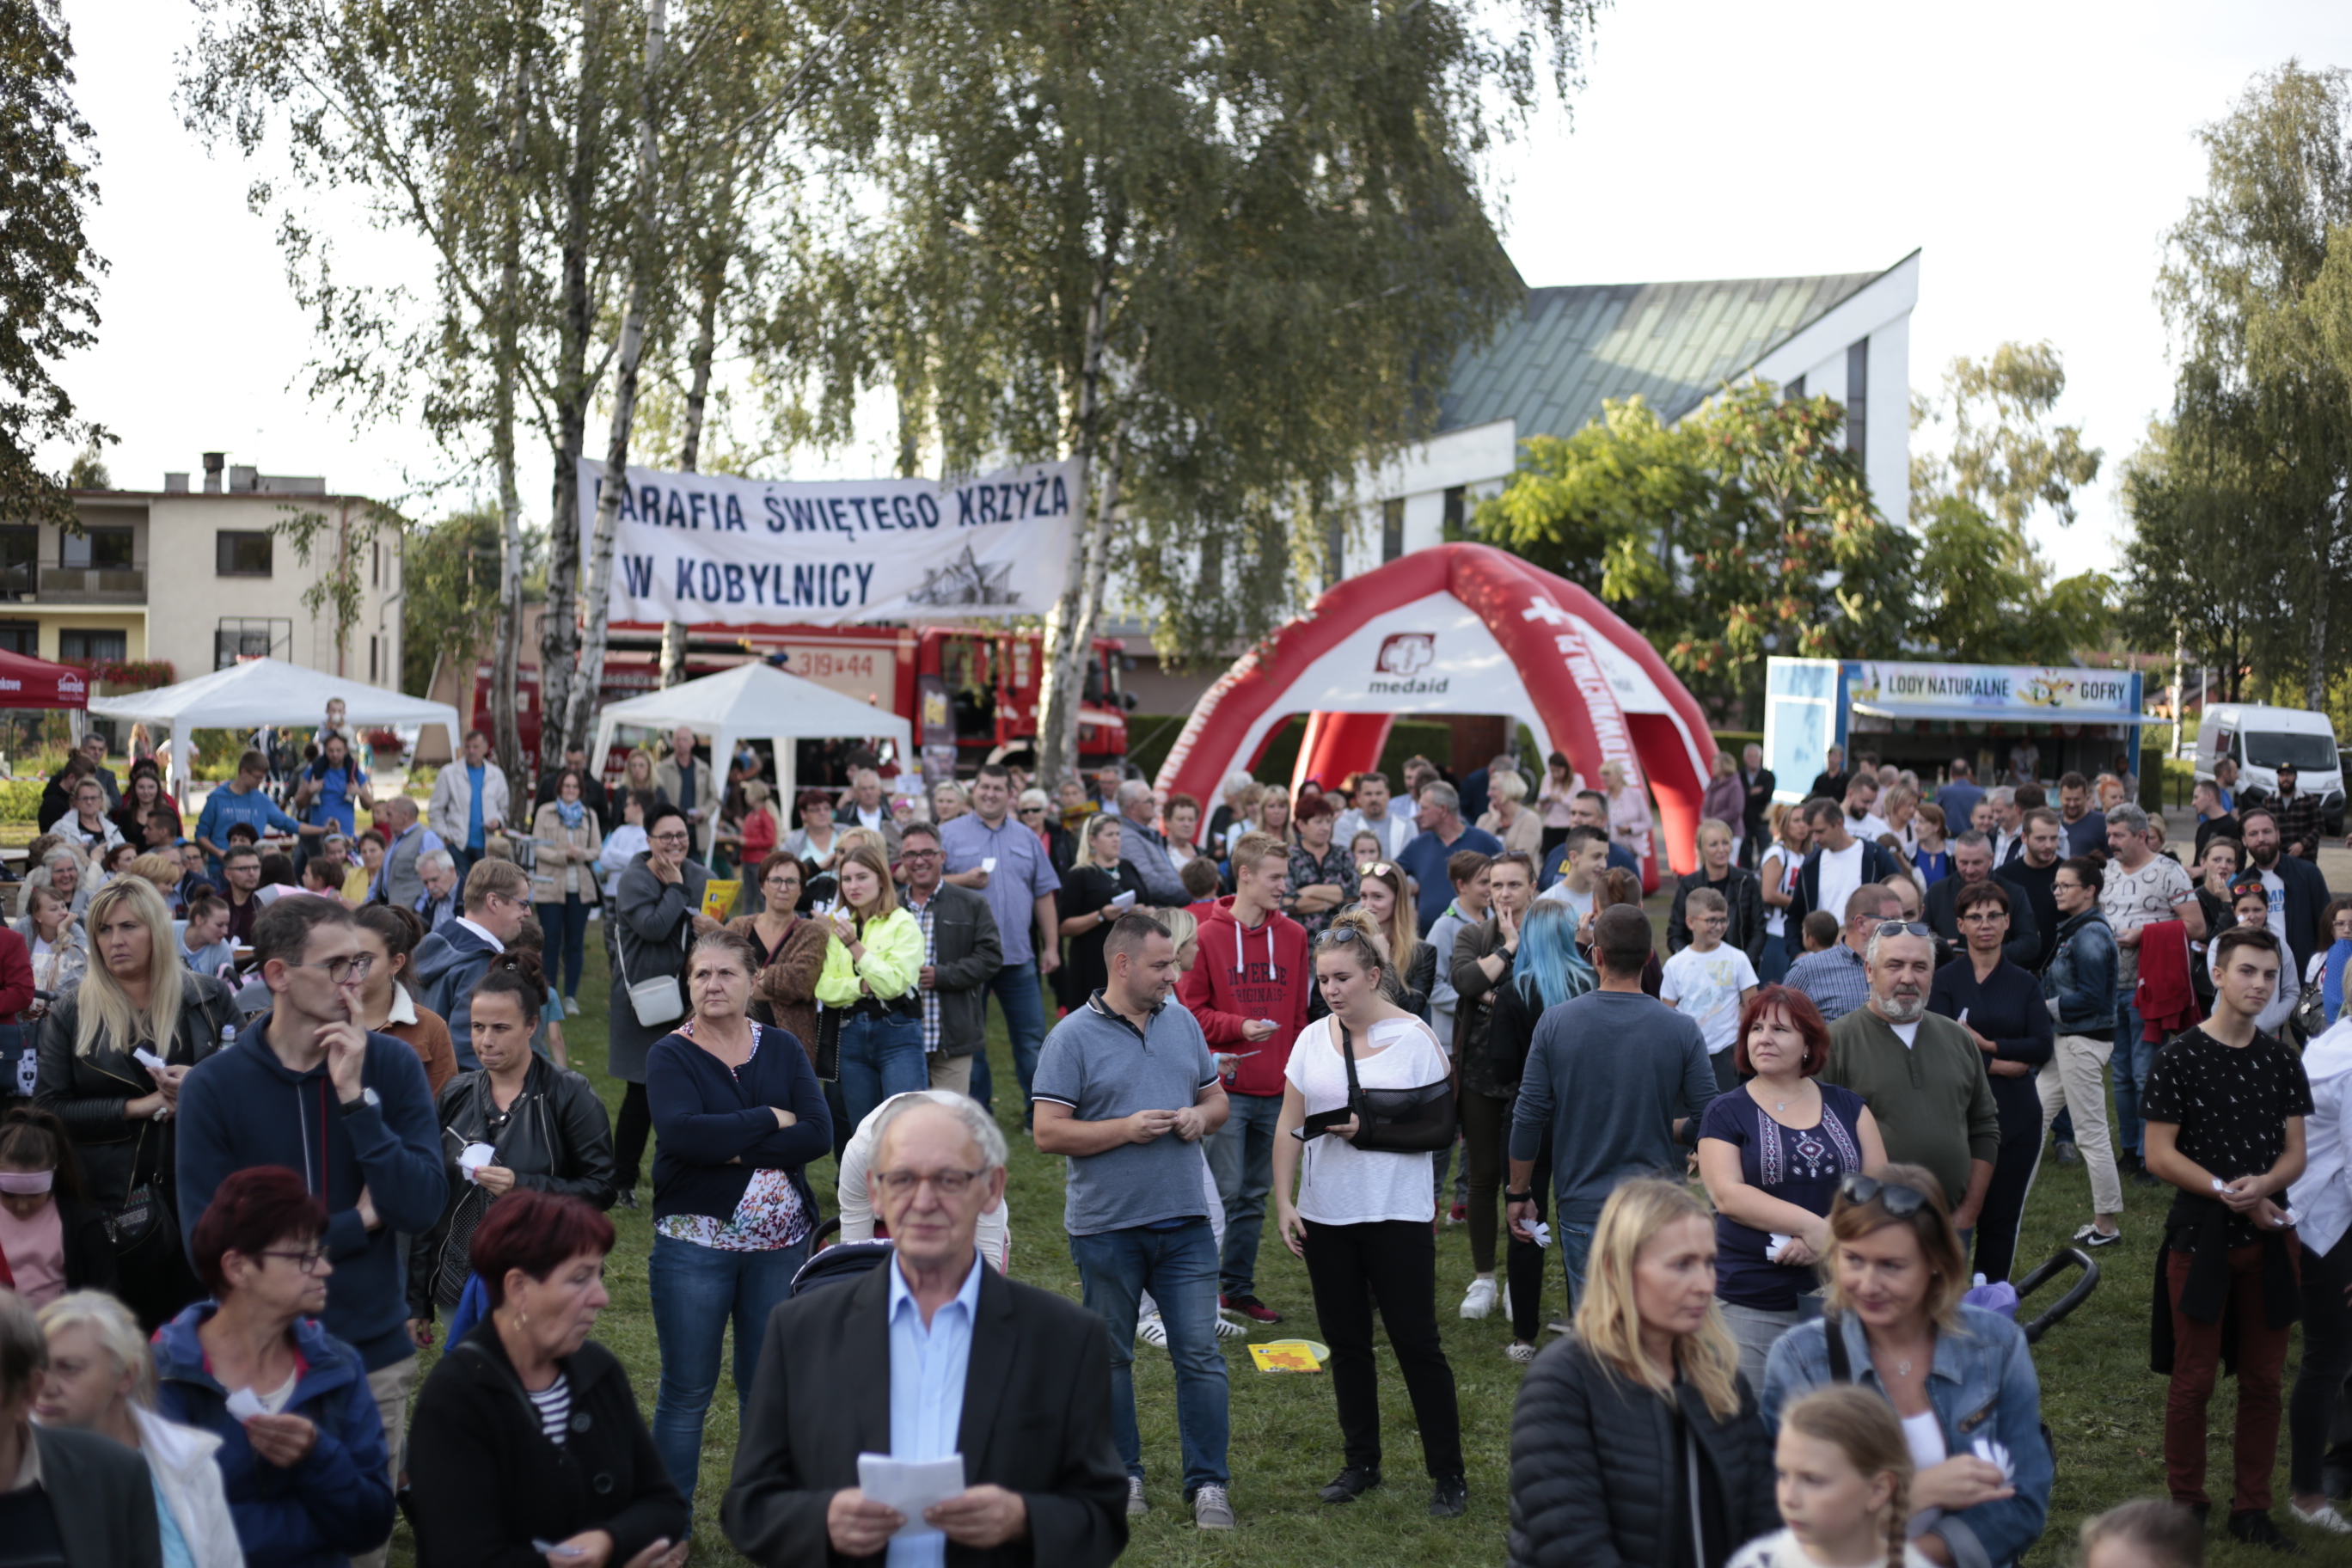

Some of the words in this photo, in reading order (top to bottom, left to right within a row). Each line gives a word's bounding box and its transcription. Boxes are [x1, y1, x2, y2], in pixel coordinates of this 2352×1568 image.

[766, 487, 940, 542] ŚWIĘTEGO
[957, 468, 1069, 527] KRZYŻA
[623, 554, 653, 599] W
[676, 556, 875, 607] KOBYLNICY
[1369, 677, 1449, 695] medaid
[1889, 676, 1926, 695] LODY
[1928, 677, 2010, 698] NATURALNE
[2080, 681, 2126, 701] GOFRY
